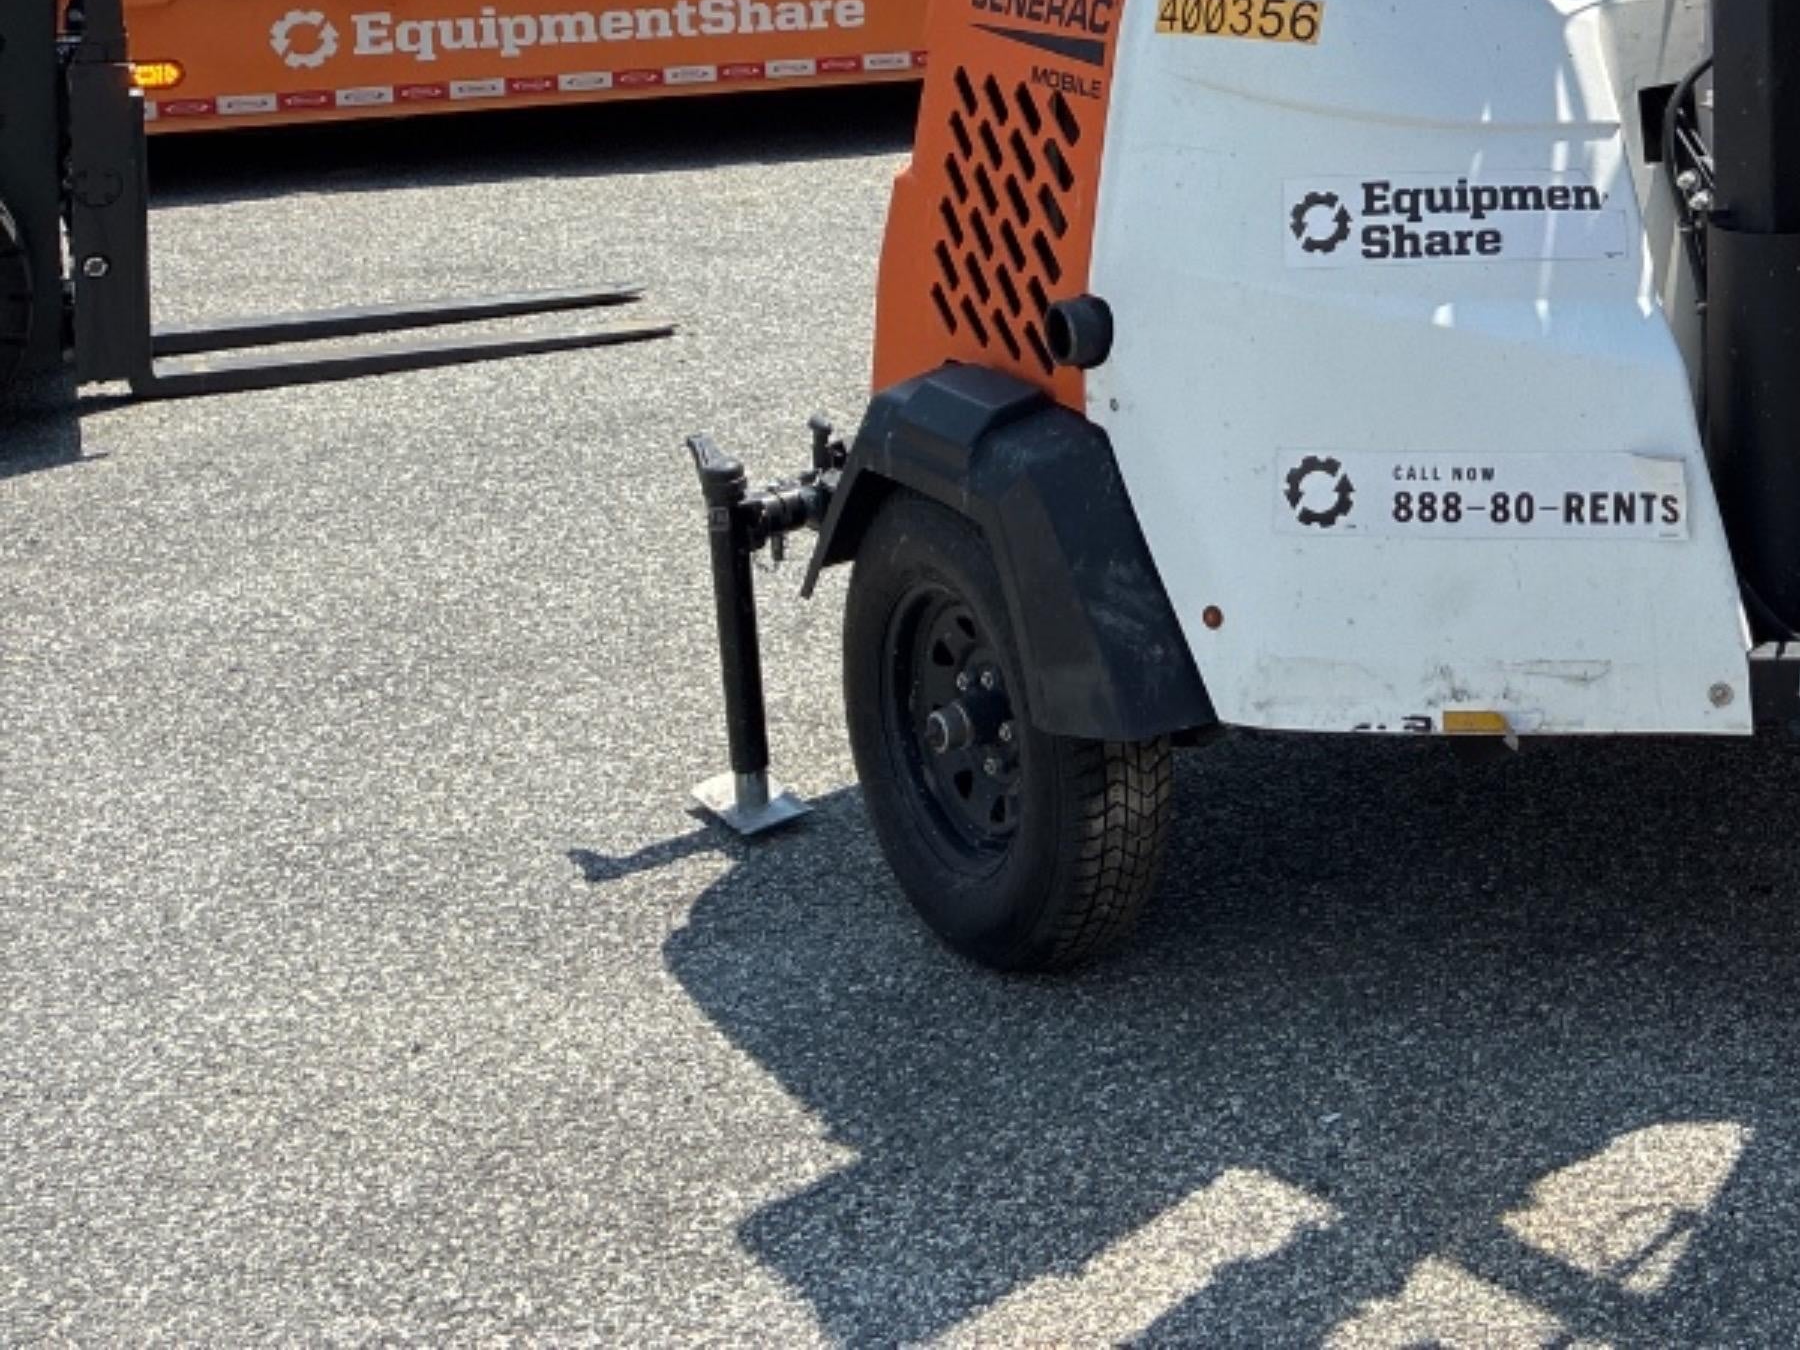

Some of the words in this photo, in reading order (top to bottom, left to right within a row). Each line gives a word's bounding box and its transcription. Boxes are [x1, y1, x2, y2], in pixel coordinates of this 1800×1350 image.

[1031, 64, 1102, 100] MOBILE
[1360, 178, 1607, 223] Equipmen
[1360, 224, 1503, 260] Share
[1391, 465, 1442, 482] CALL
[1451, 466, 1496, 482] NOW
[1391, 490, 1682, 525] 888-80-RENTS
